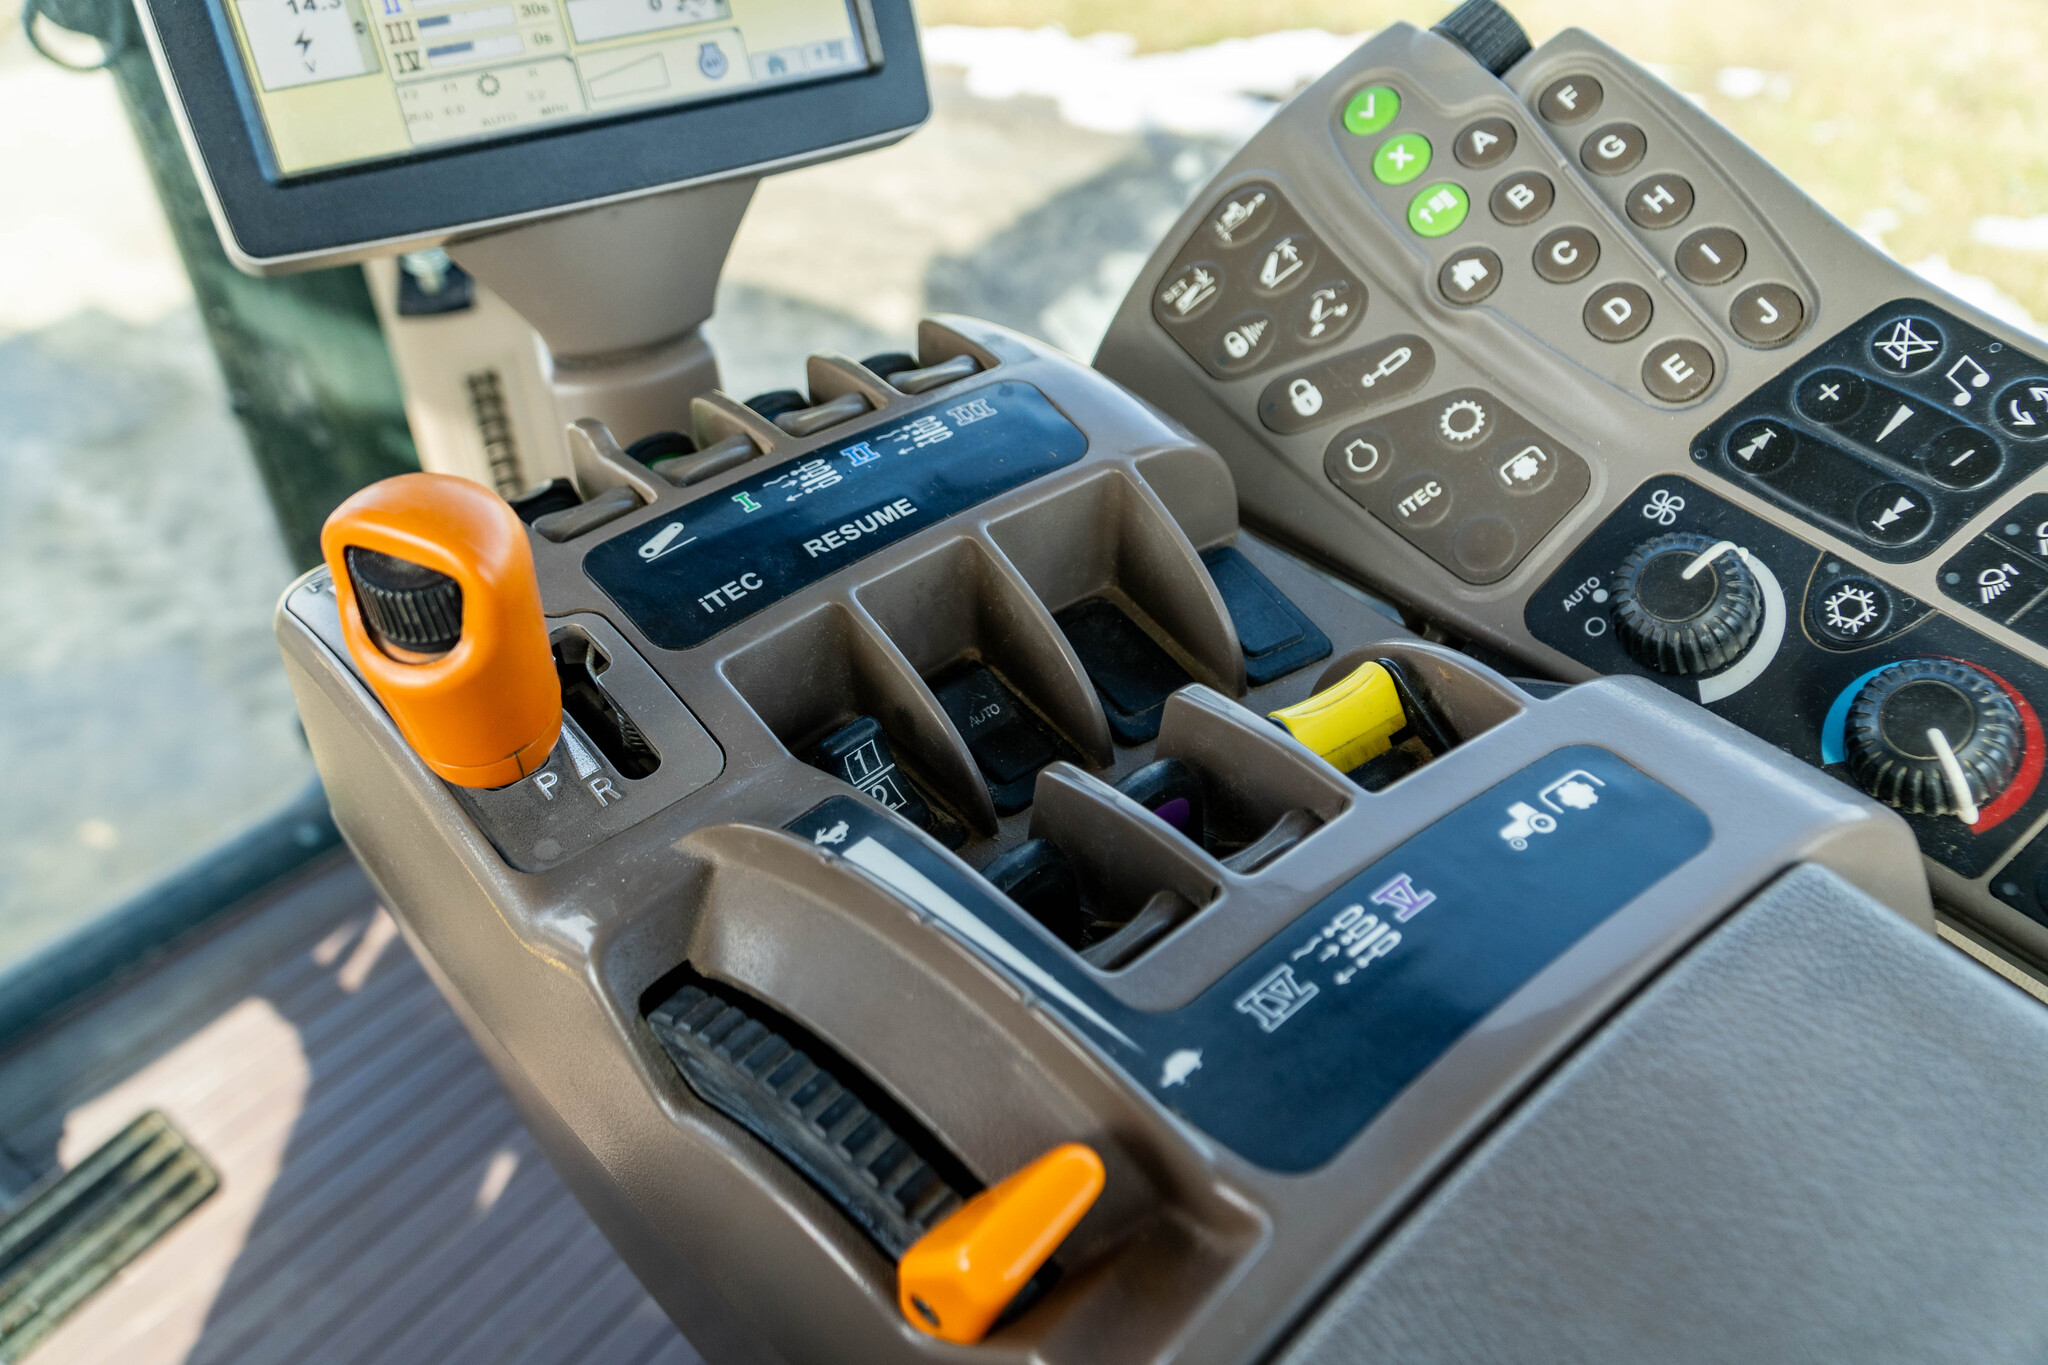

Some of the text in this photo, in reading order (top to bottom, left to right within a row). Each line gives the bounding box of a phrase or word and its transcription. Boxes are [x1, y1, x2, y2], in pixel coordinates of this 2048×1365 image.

[385, 21, 416, 44] III
[394, 50, 426, 74] IV
[1556, 86, 1579, 110] F
[1472, 130, 1499, 155] A
[1599, 133, 1627, 159] G
[1506, 183, 1536, 210] B
[1643, 184, 1675, 214] H
[1551, 240, 1578, 266] C
[1700, 243, 1721, 265] I
[1162, 278, 1188, 305] SET
[1601, 296, 1632, 325] D
[1758, 296, 1779, 324] J
[1660, 352, 1695, 384] E
[946, 398, 998, 427] III
[840, 441, 881, 467] II
[1398, 480, 1442, 518] iTEC
[803, 497, 918, 558] RESUME
[697, 571, 763, 614] iTEC
[1562, 575, 1601, 612] AUTO
[969, 702, 1001, 729] AUTO
[853, 749, 869, 775] 1
[533, 771, 558, 800] P
[587, 777, 622, 808] R
[871, 784, 897, 808] 2
[1370, 871, 1437, 923] V
[1233, 962, 1320, 1033] IV
